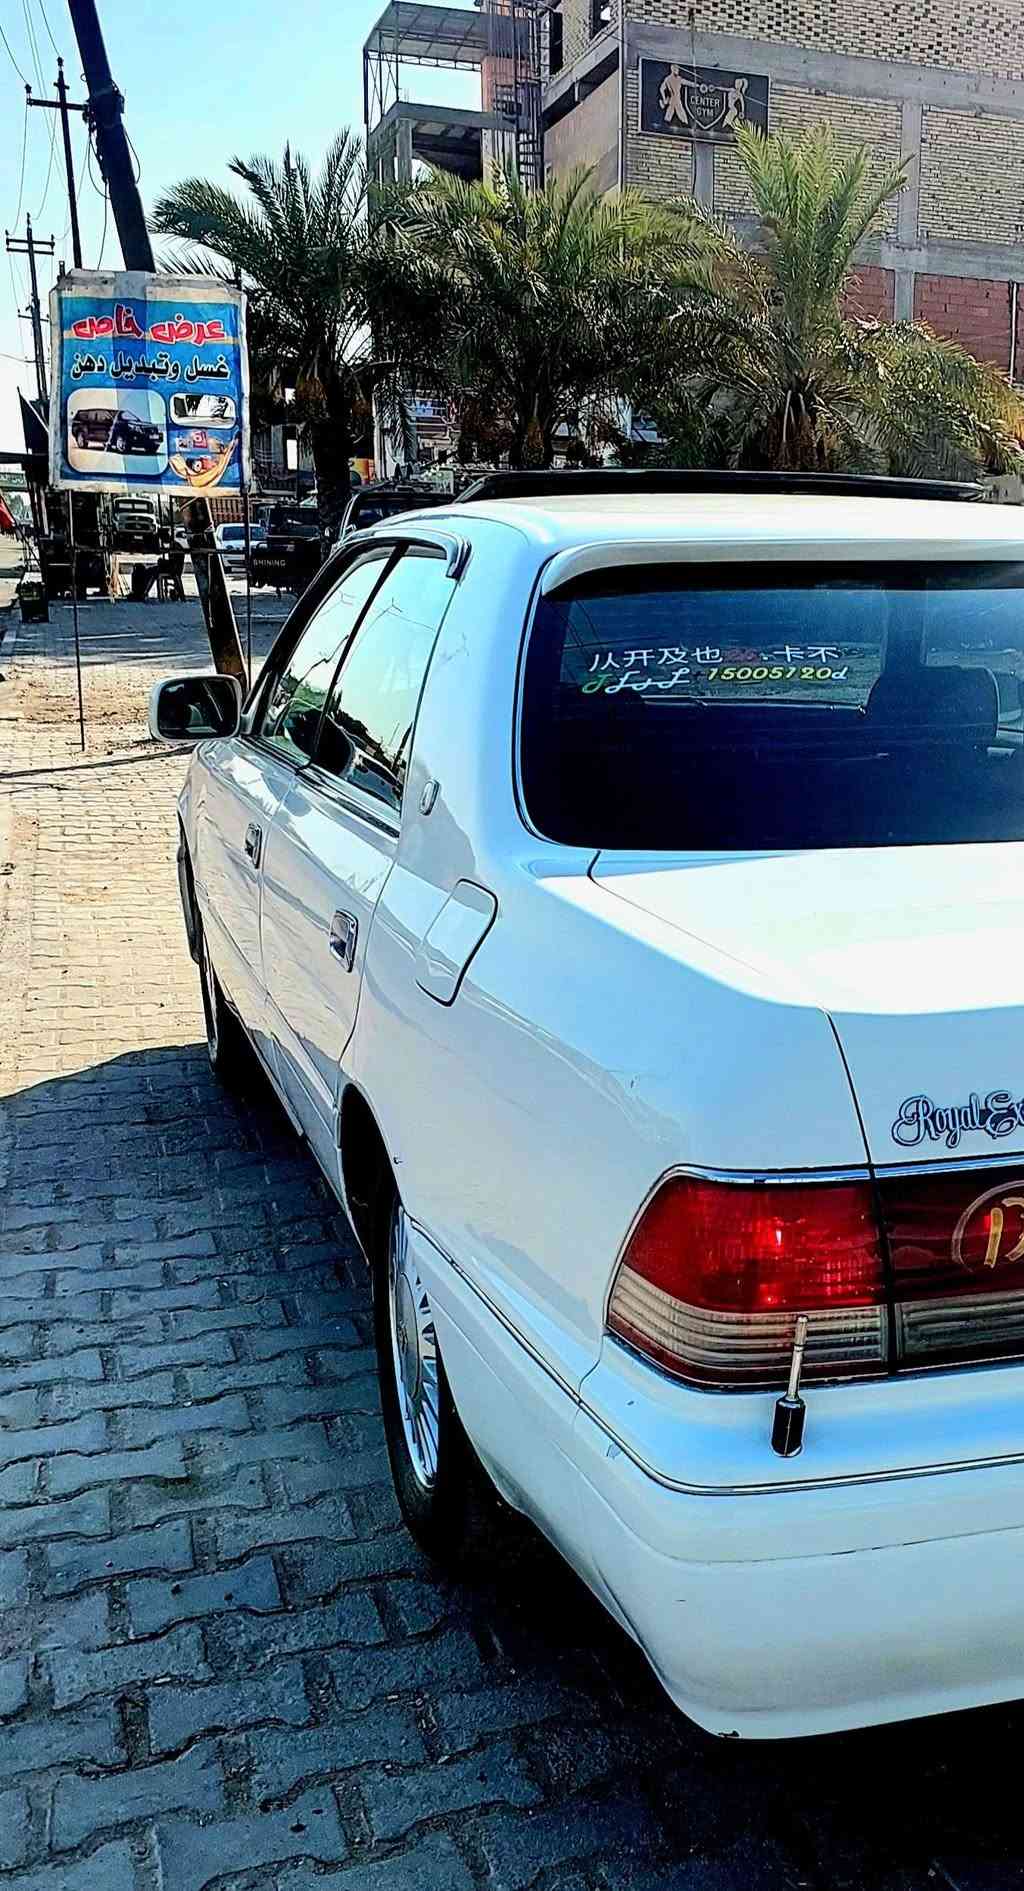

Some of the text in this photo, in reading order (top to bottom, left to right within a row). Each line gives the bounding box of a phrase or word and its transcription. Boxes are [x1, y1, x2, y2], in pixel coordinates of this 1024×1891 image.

[690, 95, 720, 108] CENTER
[696, 107, 714, 117] GYM
[72, 303, 226, 345] عرض خاص
[71, 350, 230, 384] غسل وتبديل دهن
[891, 1092, 987, 1149] Royal
